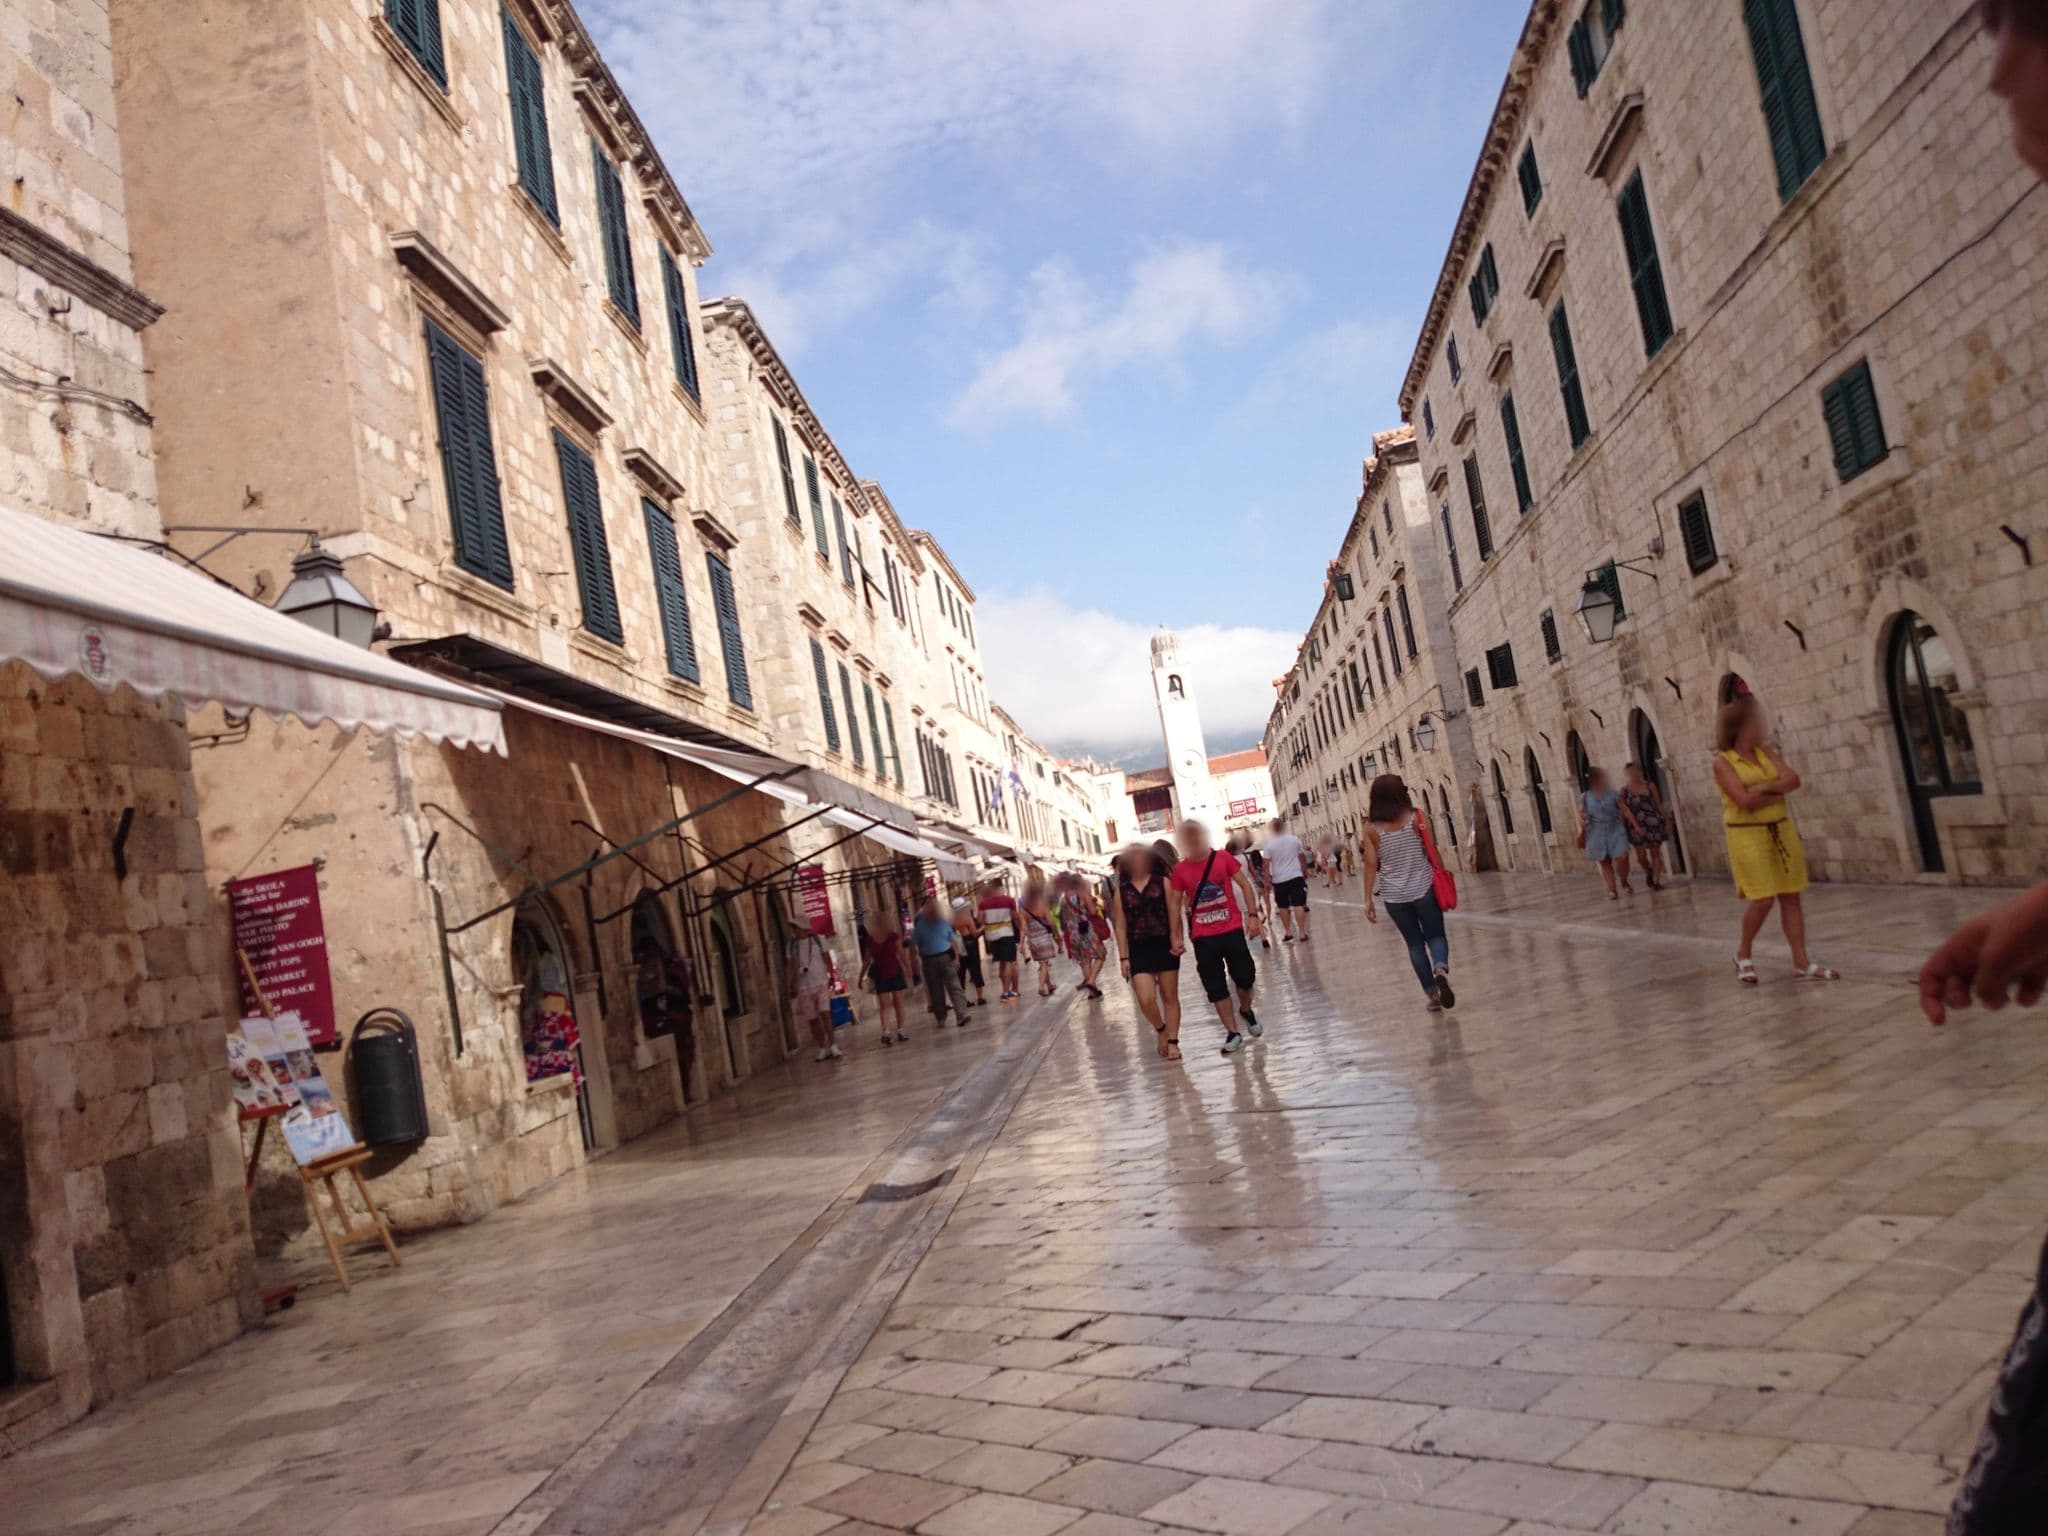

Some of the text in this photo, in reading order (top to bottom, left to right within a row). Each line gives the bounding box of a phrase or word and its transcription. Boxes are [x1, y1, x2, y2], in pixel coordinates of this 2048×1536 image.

[259, 922, 290, 934] PHOTO
[277, 942, 296, 952] VAN
[296, 935, 324, 948] GOGH
[271, 968, 306, 983] MARKET
[281, 983, 316, 998] PALACE
